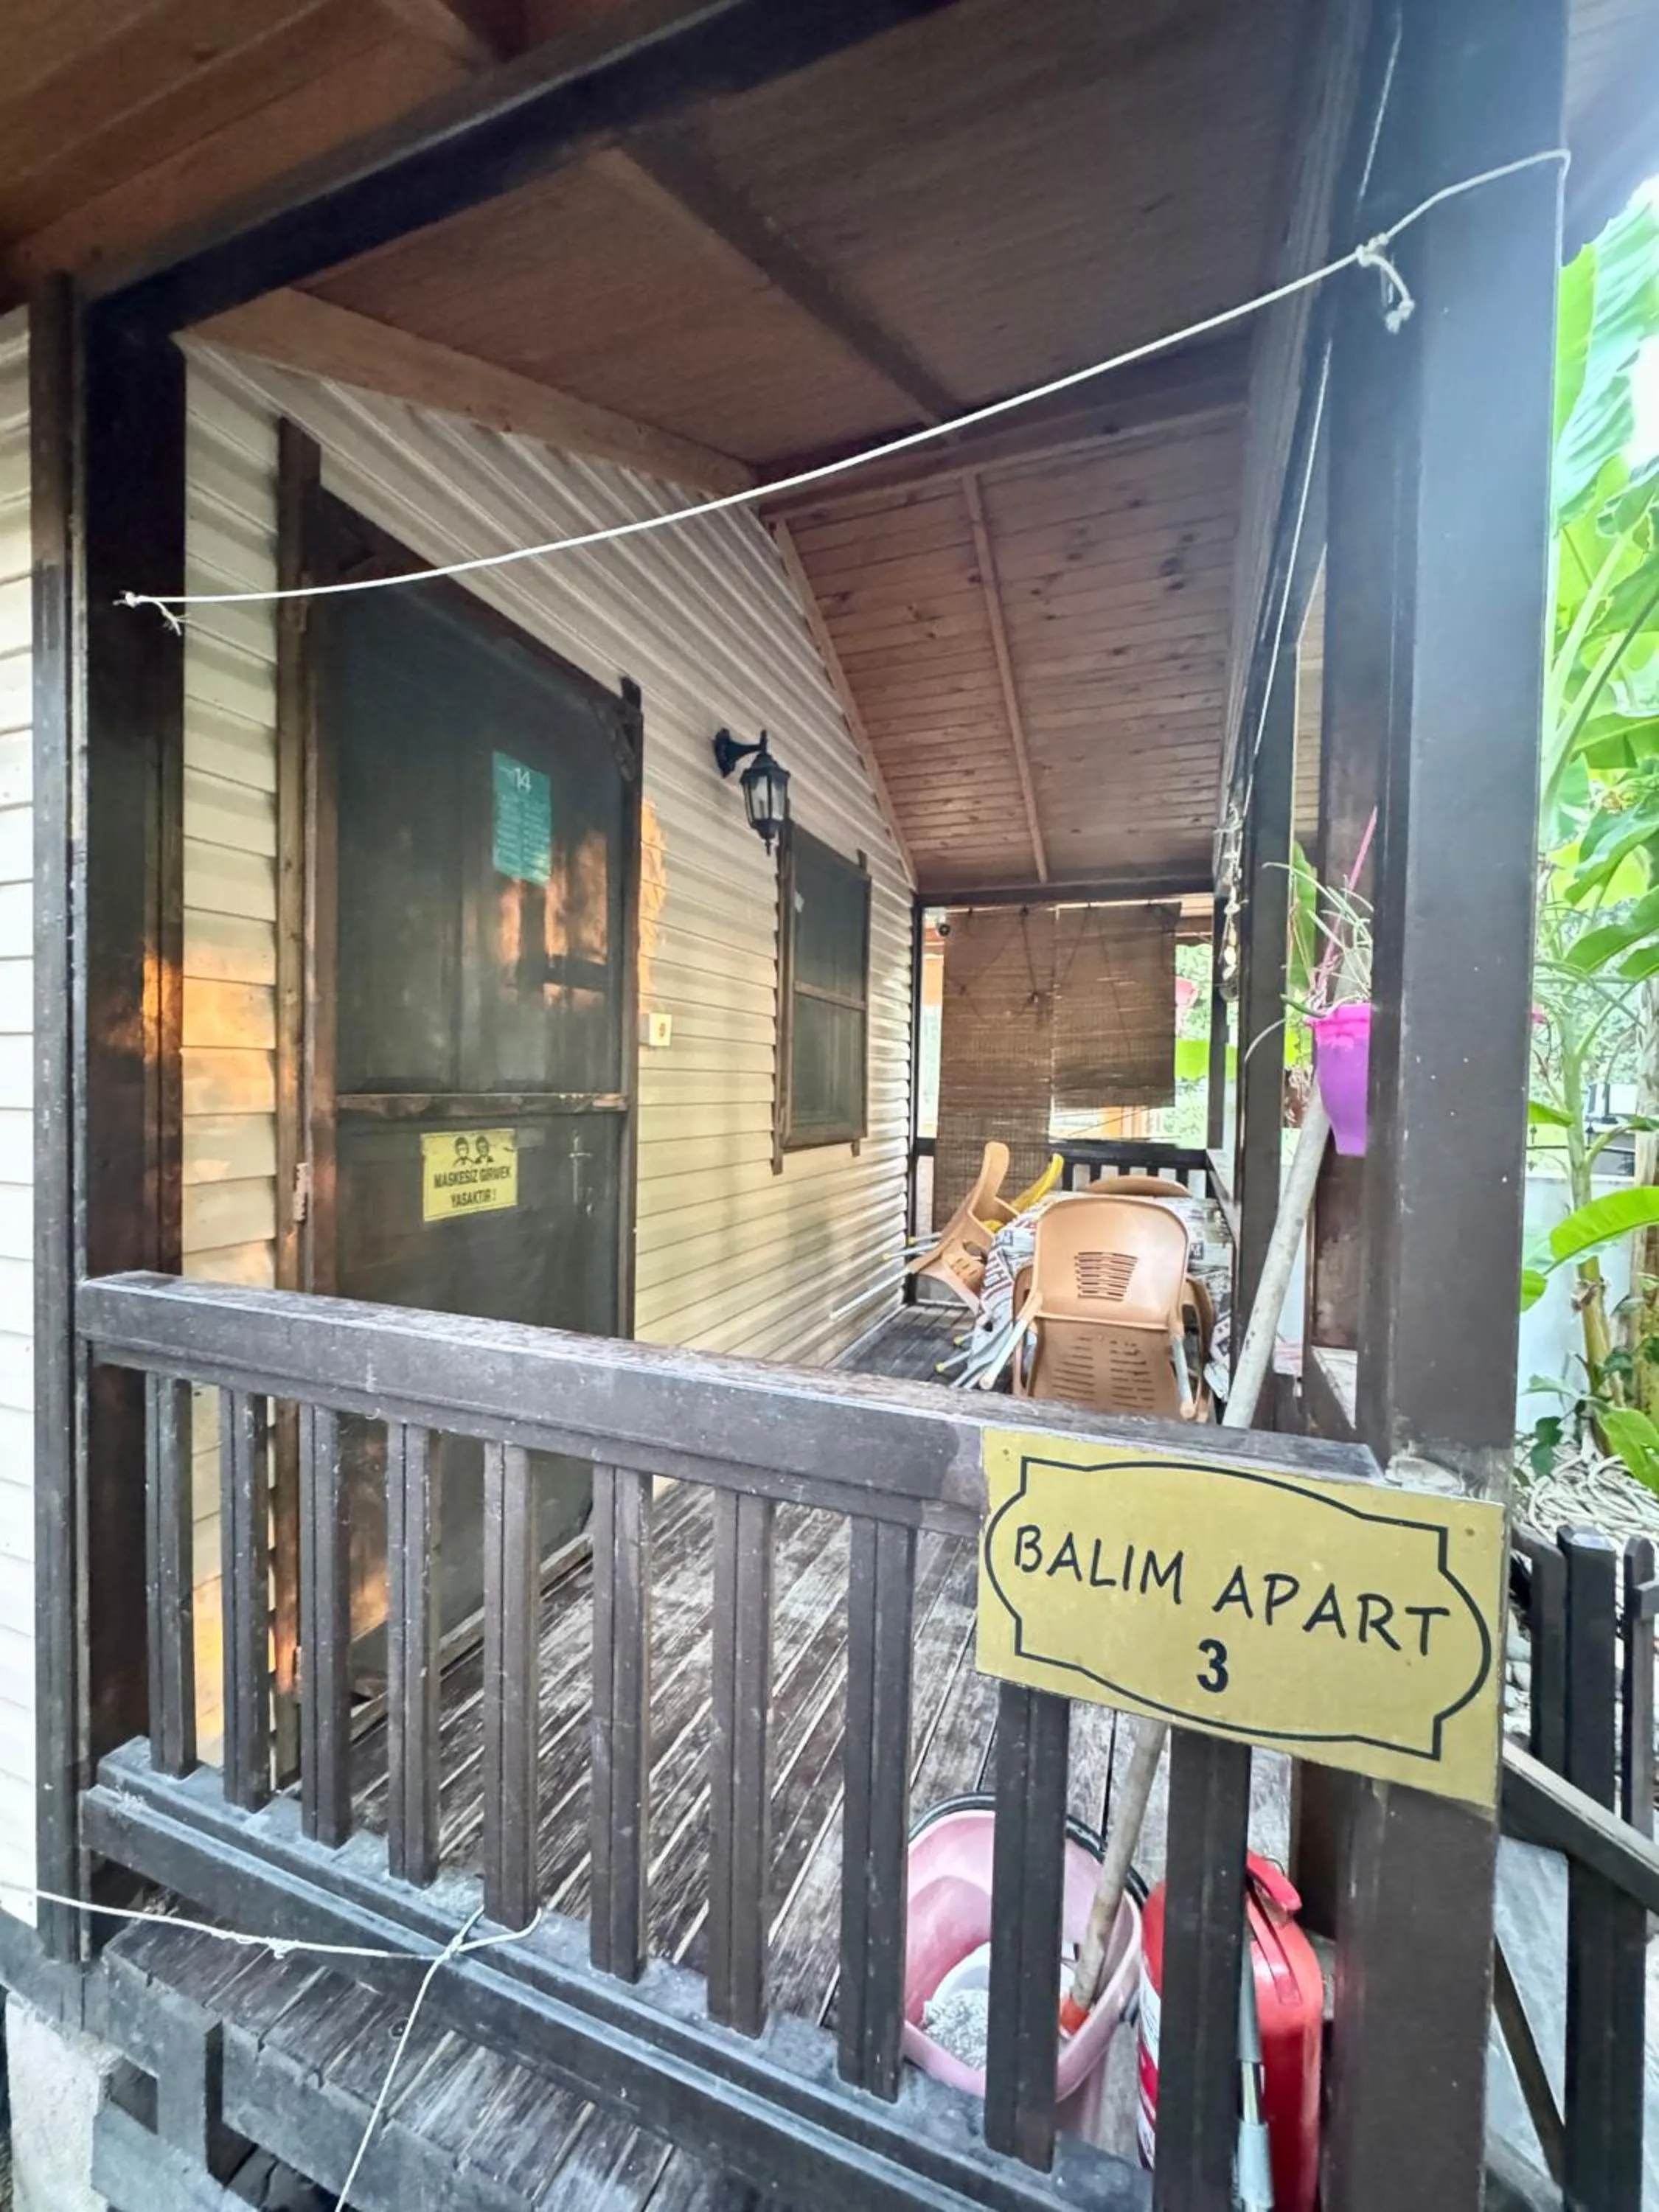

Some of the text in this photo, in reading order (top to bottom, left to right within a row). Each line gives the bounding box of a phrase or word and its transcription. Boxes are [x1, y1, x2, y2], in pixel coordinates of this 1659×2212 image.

[1014, 1523, 1450, 1656] BALIM APART
[1197, 1638, 1228, 1693] 3
